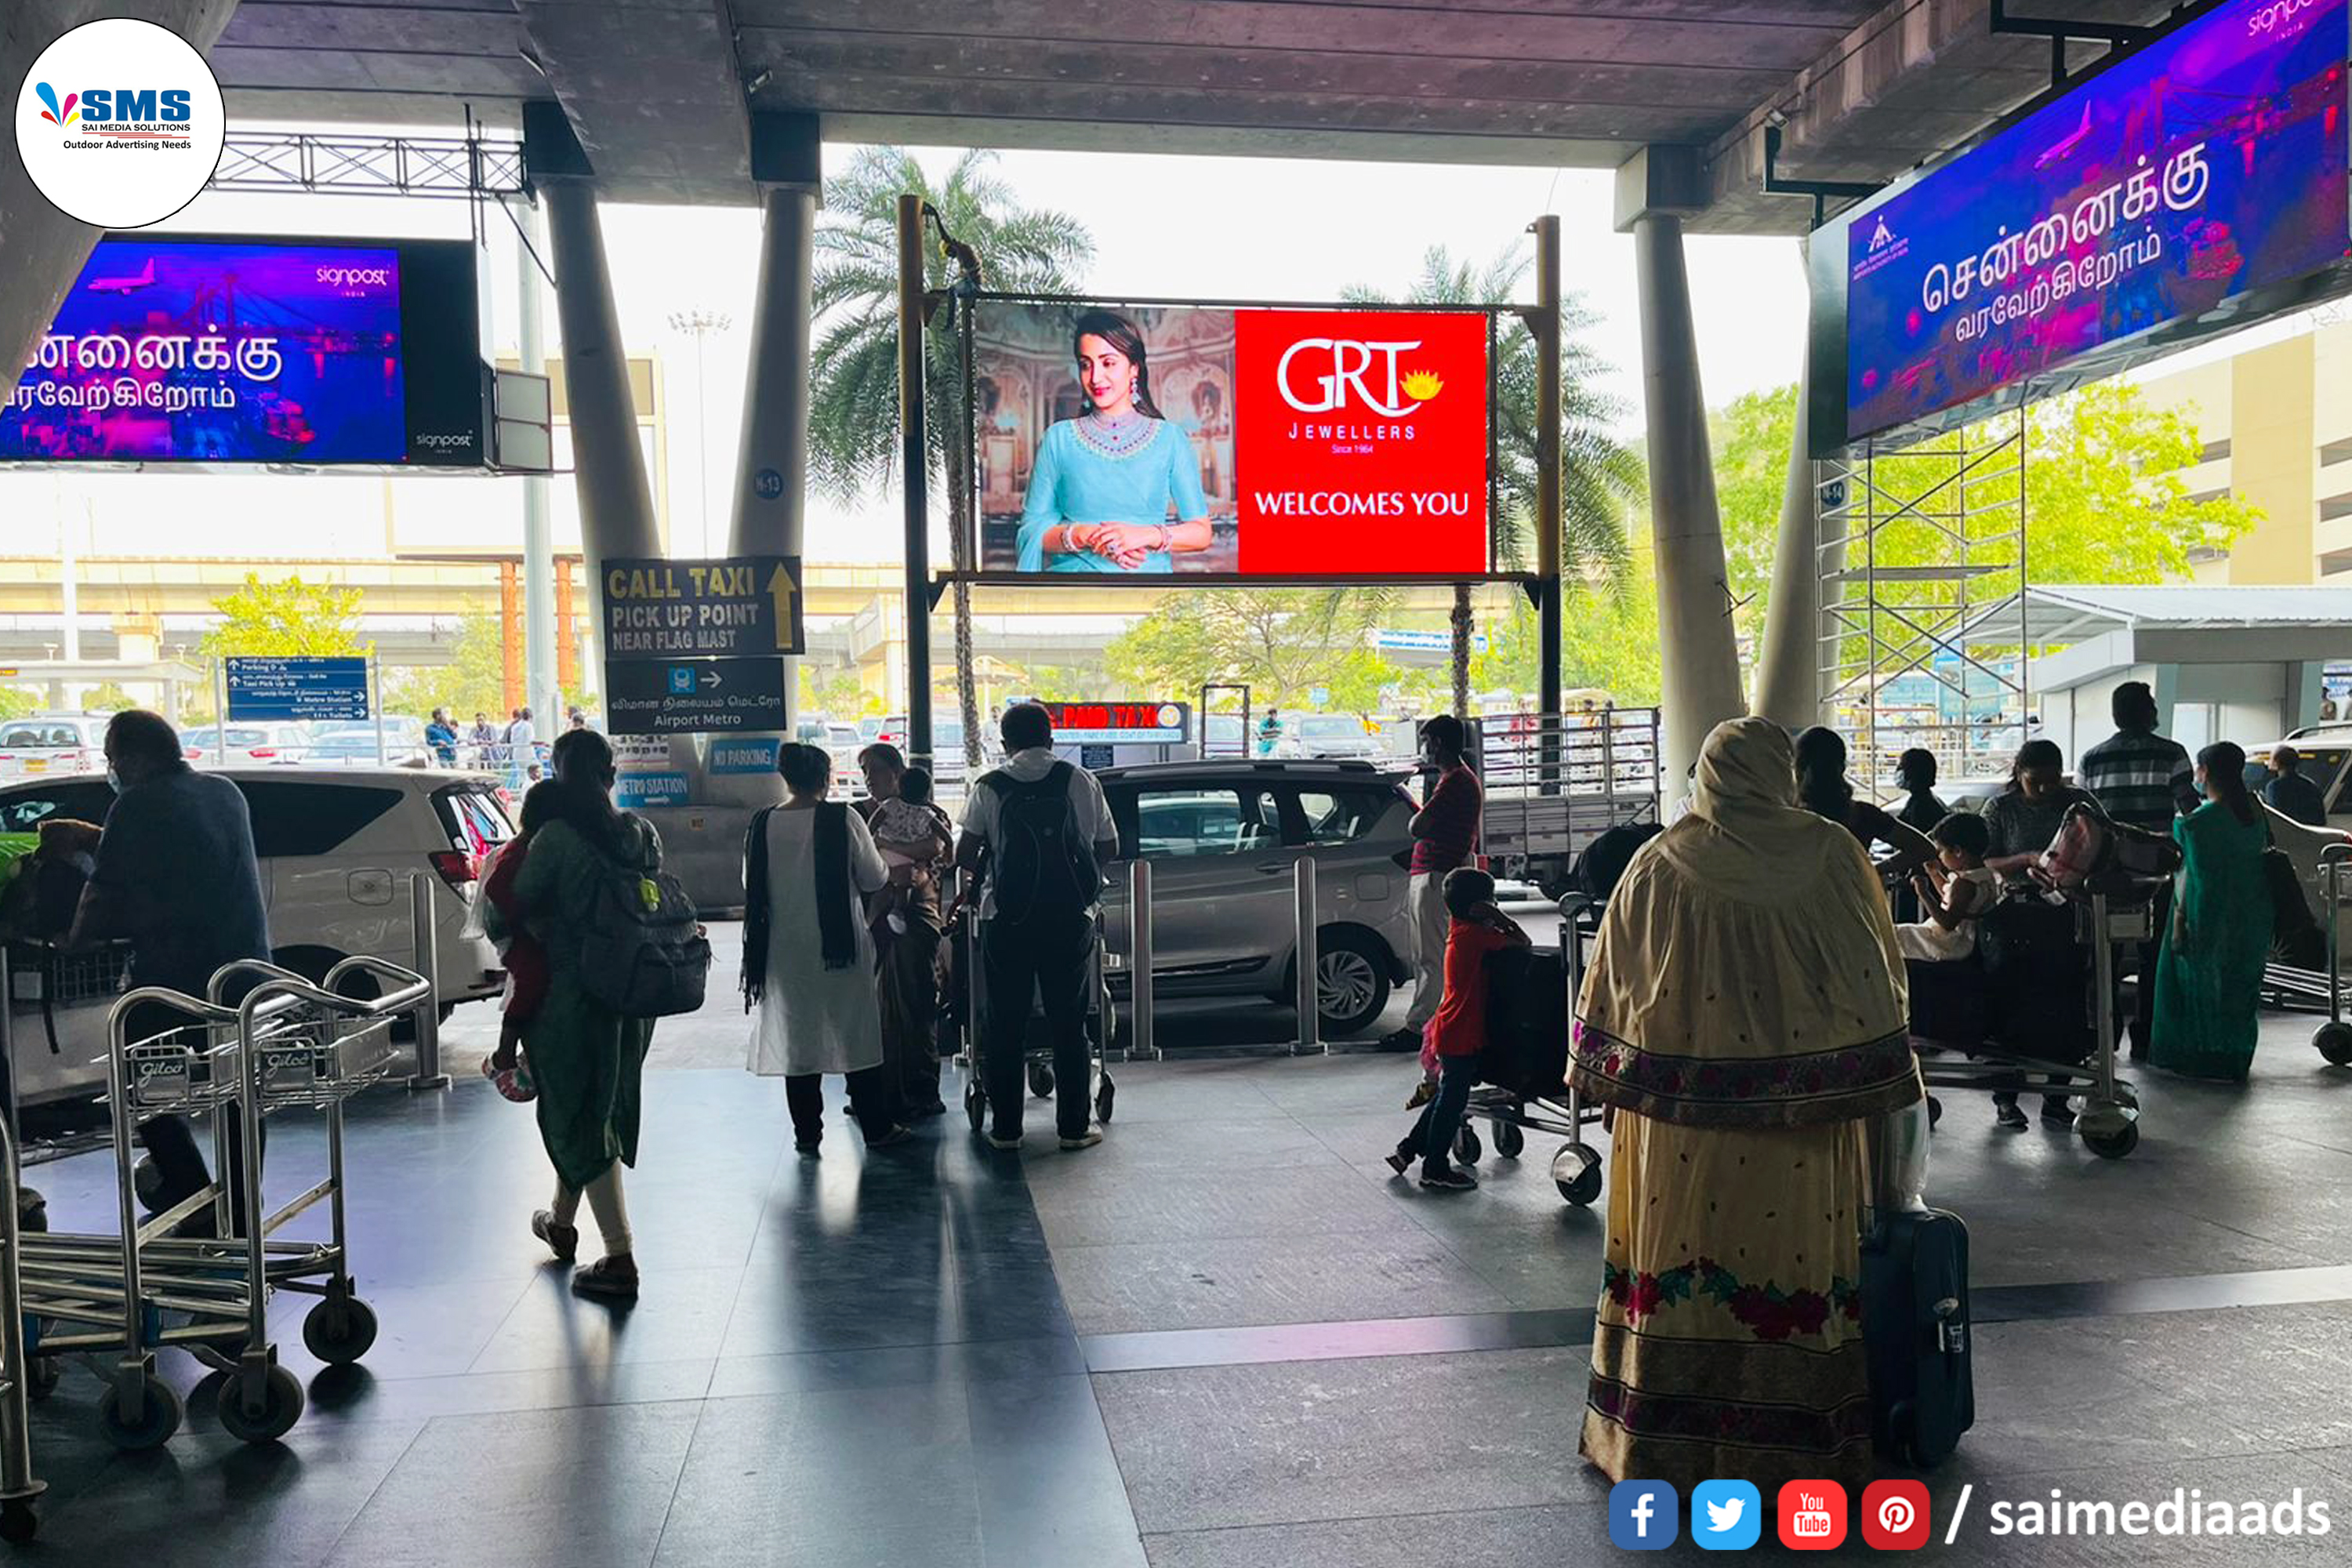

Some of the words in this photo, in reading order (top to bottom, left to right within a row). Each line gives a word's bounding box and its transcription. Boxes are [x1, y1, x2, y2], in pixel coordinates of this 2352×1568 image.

[1922, 142, 2211, 314] சென்னைக்கு
[316, 265, 387, 287] signpost
[1955, 224, 2162, 343] வரவேற்கிறோம்
[26, 324, 283, 382] ன்னைக்கு
[1276, 337, 1423, 418] GRT
[1288, 422, 1416, 440] JEWELLERS
[1331, 444, 1352, 454] Since
[1254, 492, 1405, 516] WELCOMES
[1410, 492, 1469, 516] YOU
[608, 568, 681, 599] CALL
[688, 566, 756, 597] TAXI
[612, 605, 660, 628] PICK
[666, 604, 692, 627] UP
[699, 603, 758, 626] POINT
[612, 630, 653, 651] NEAR
[655, 630, 693, 649] FLAG
[696, 629, 737, 649] MAST
[654, 714, 699, 728] Airport
[702, 713, 742, 725] Metro
[713, 750, 726, 766] NO
[728, 749, 771, 765] PARKING
[646, 776, 688, 795] STATION
